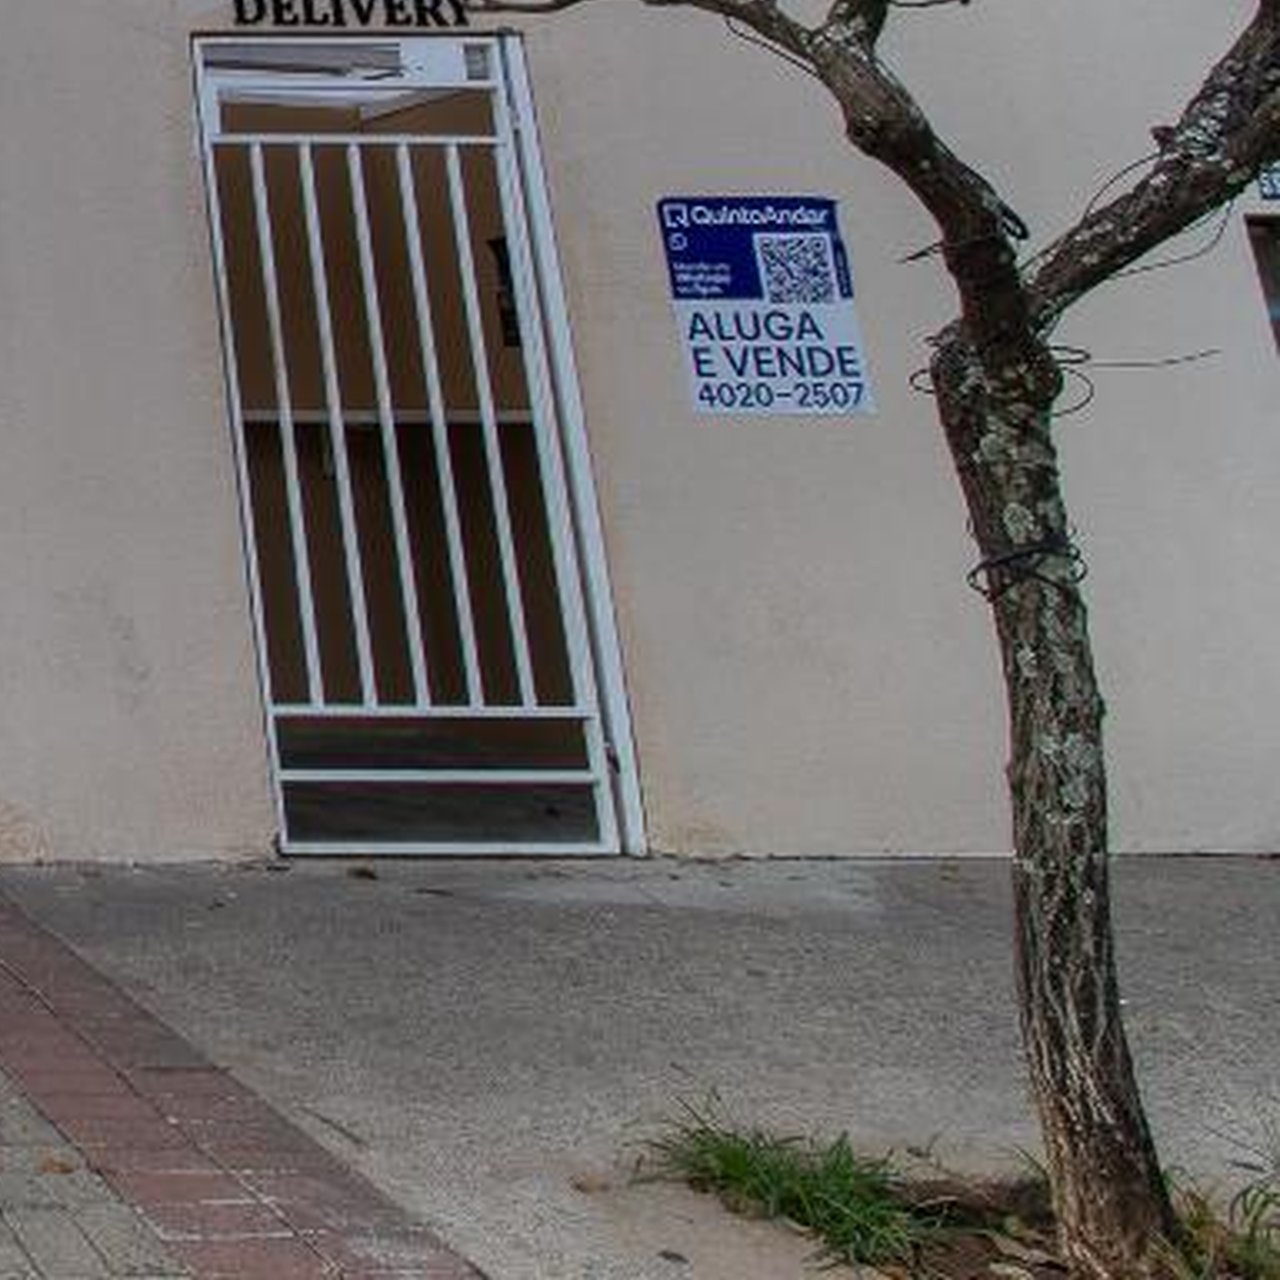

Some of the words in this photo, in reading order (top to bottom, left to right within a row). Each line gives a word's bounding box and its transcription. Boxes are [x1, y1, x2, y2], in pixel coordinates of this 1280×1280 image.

[689, 311, 825, 341] ALUGA
[693, 346, 718, 378] E
[721, 346, 862, 378] VENDE
[698, 381, 865, 408] 4020-2507
